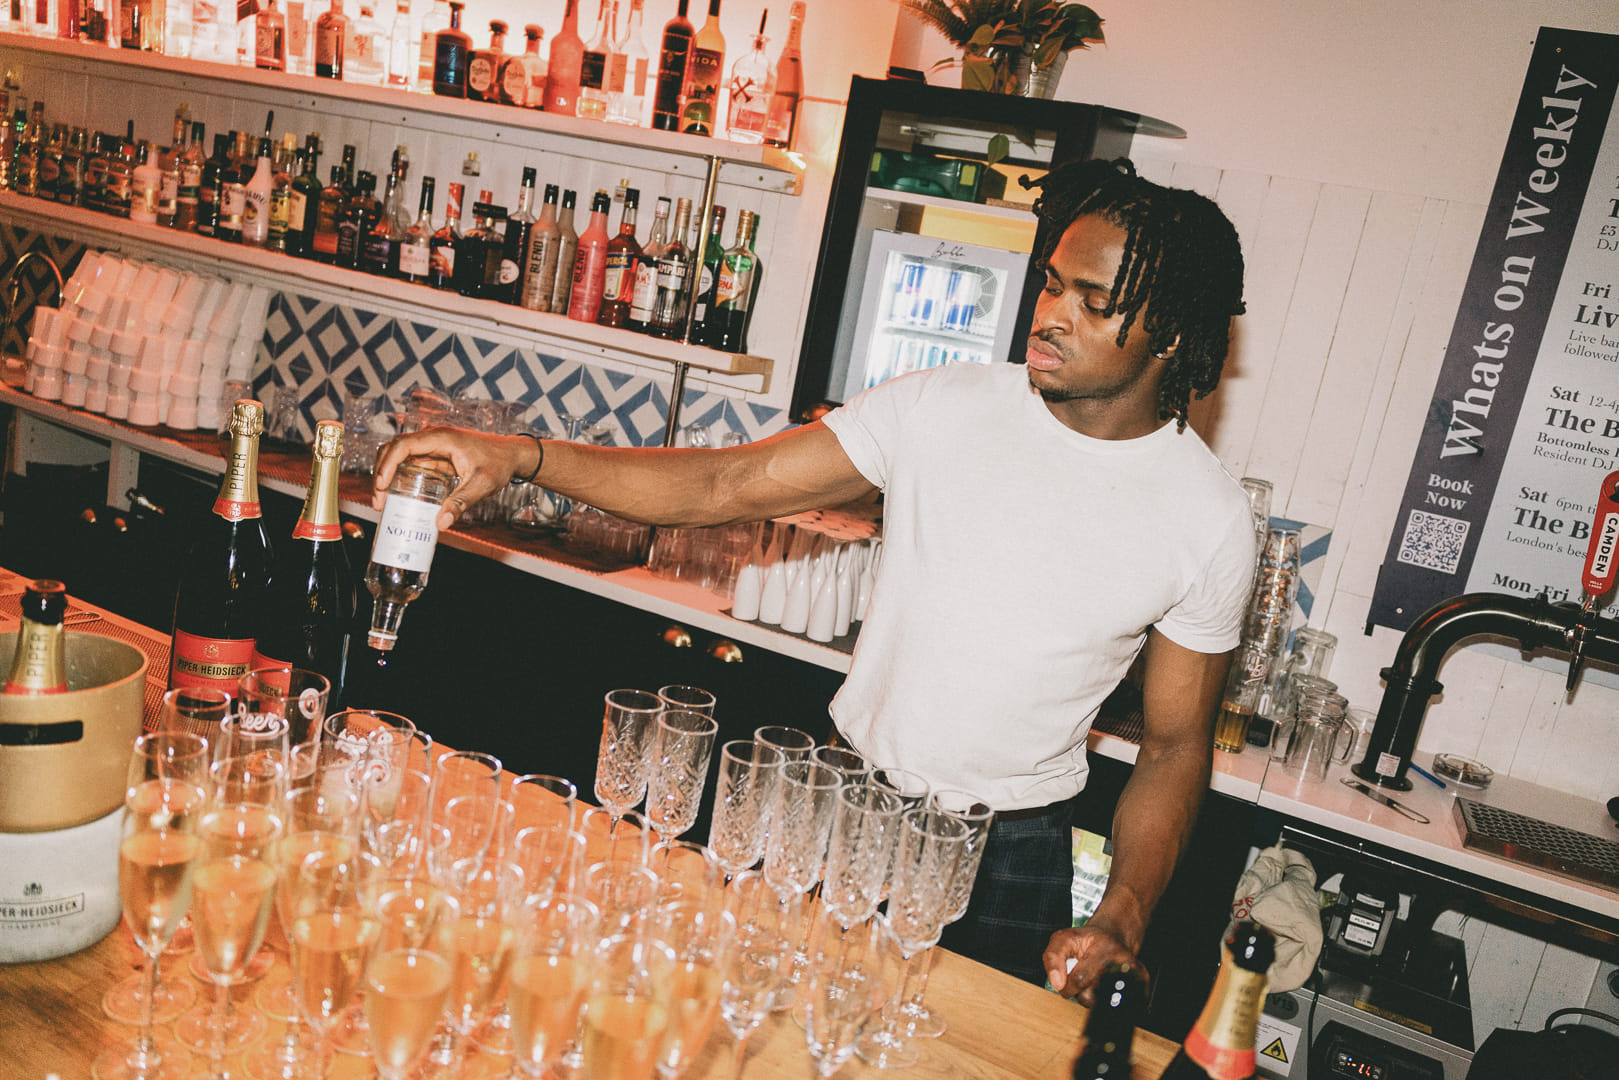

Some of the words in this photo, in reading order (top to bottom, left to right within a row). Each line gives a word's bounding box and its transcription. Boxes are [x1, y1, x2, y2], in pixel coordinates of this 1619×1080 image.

[1505, 63, 1598, 241] Weekly
[1597, 238, 1619, 252] DJ
[1494, 254, 1537, 312] on
[1582, 282, 1612, 299] Fri
[1574, 303, 1619, 329] Liv
[1569, 329, 1597, 345] Live
[1563, 343, 1619, 363] followed
[1440, 321, 1515, 460] Whats
[1549, 385, 1581, 403] Sat
[1544, 407, 1596, 434] The
[1536, 431, 1610, 456] Bottomless
[1532, 445, 1587, 466] Resident
[1591, 456, 1614, 471] DJ
[229, 452, 247, 491] PIPER
[1427, 472, 1475, 496] Book
[1423, 490, 1468, 511] Now
[1518, 486, 1550, 504] Sat
[1555, 496, 1584, 512] 6pm
[1513, 506, 1565, 535] The
[1506, 530, 1563, 554] London's
[1595, 517, 1619, 573] CAMDEN
[177, 658, 198, 673] PIPER
[200, 664, 246, 677] HEIDSIECK
